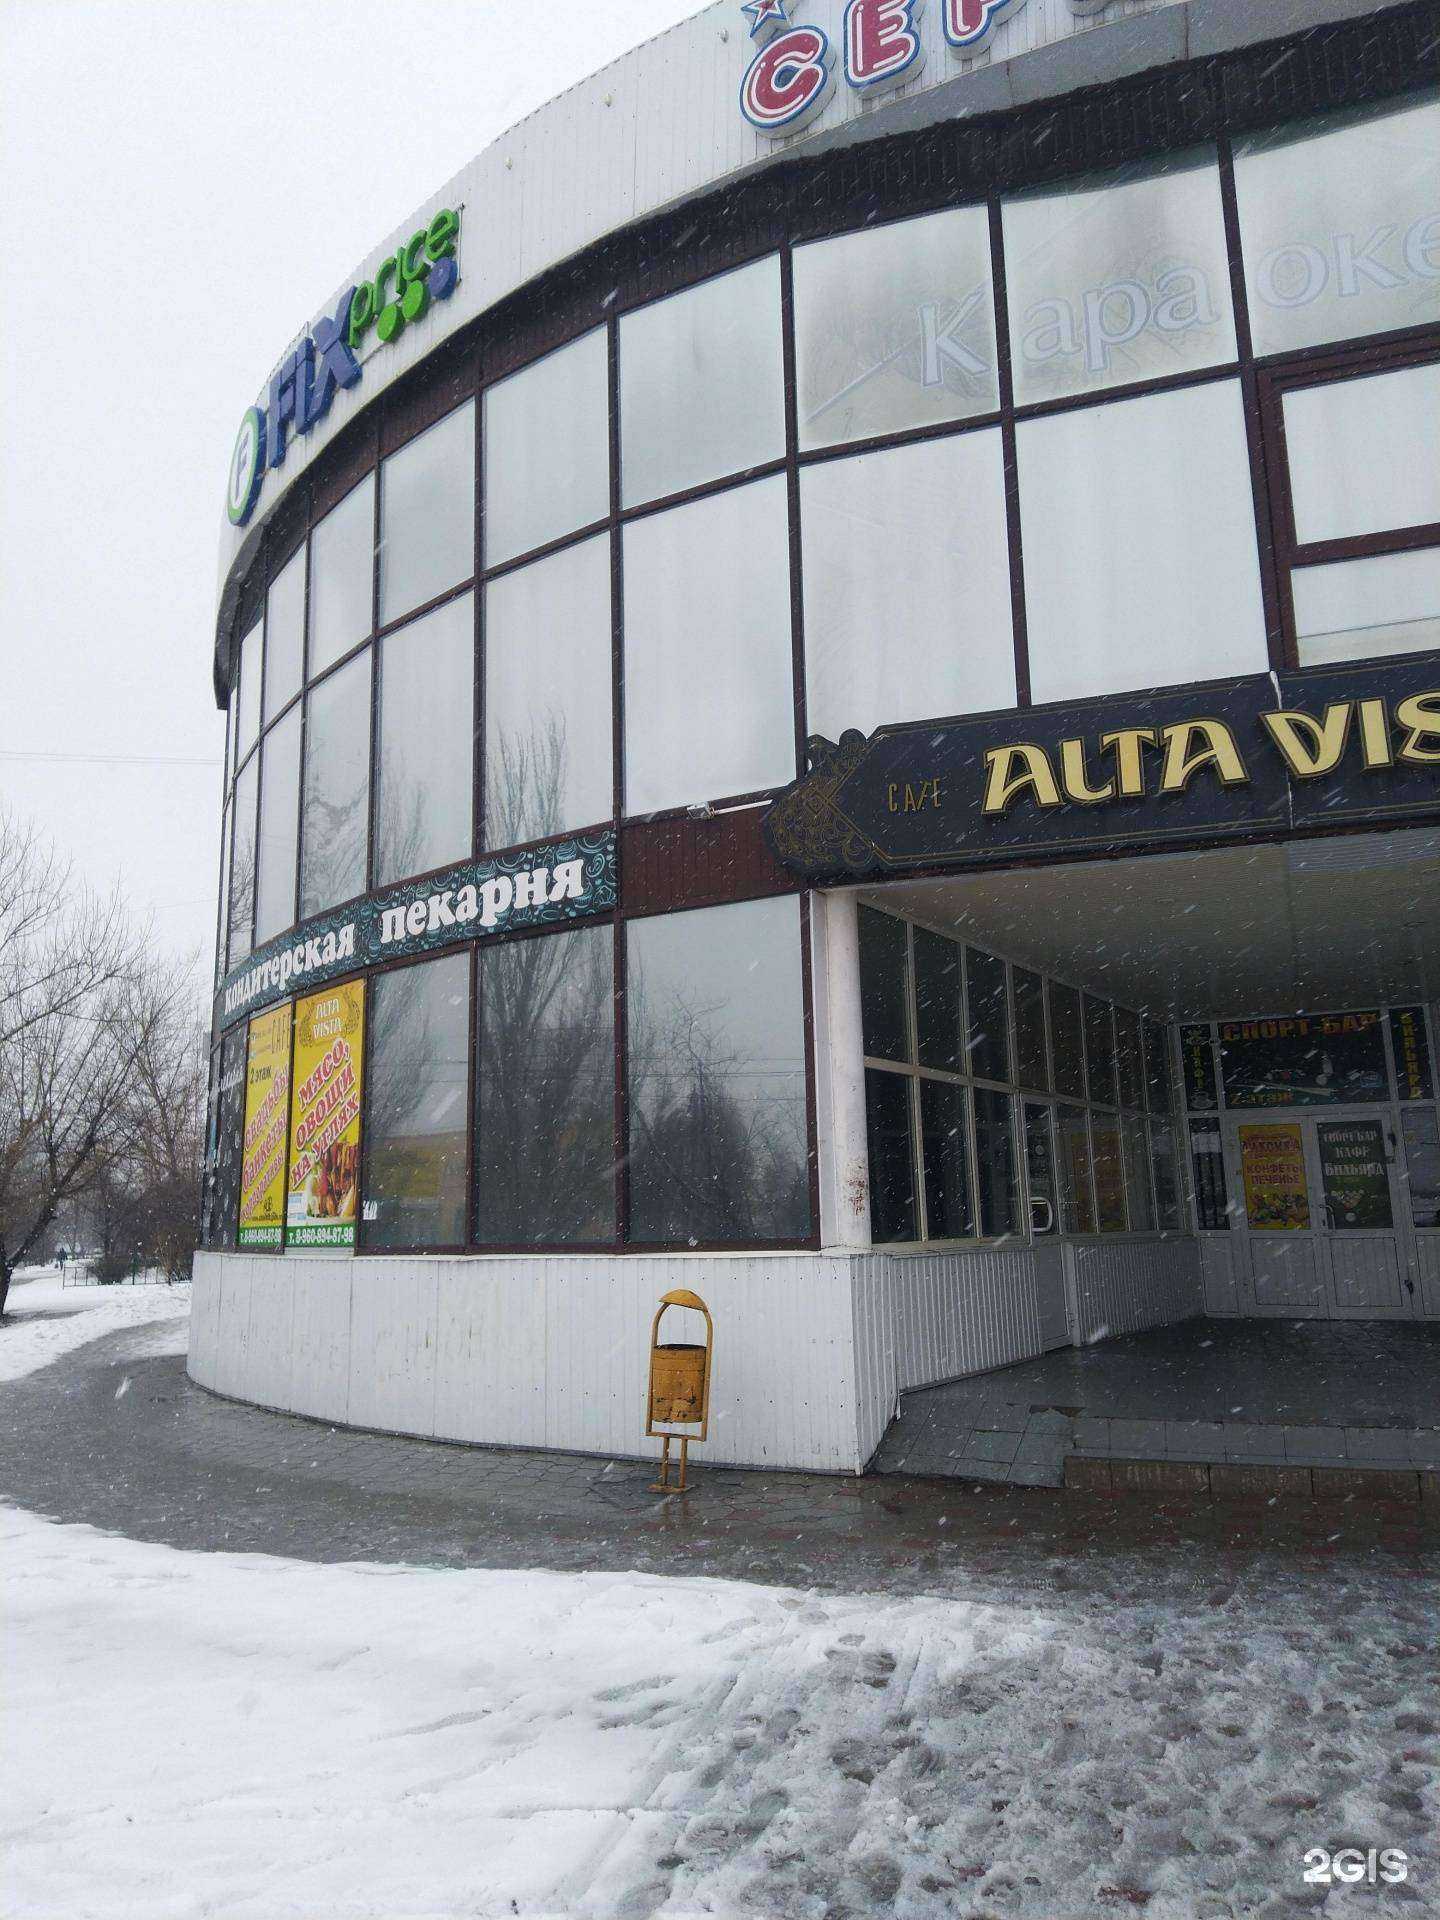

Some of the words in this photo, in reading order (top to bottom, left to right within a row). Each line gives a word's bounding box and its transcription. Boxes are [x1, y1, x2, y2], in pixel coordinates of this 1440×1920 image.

[349, 208, 460, 350] price
[982, 718, 1250, 814] ALTA
[224, 923, 355, 1015] кондитерская
[380, 858, 584, 943] пекарня
[313, 1017, 342, 1039] VISTA
[315, 998, 340, 1020] ALTA
[291, 1154, 313, 1189] НА
[312, 1094, 360, 1162] УГЛЯХ
[296, 1063, 355, 1150] ОВОЩИ
[1325, 1162, 1384, 1177] БИЛЬЯРД
